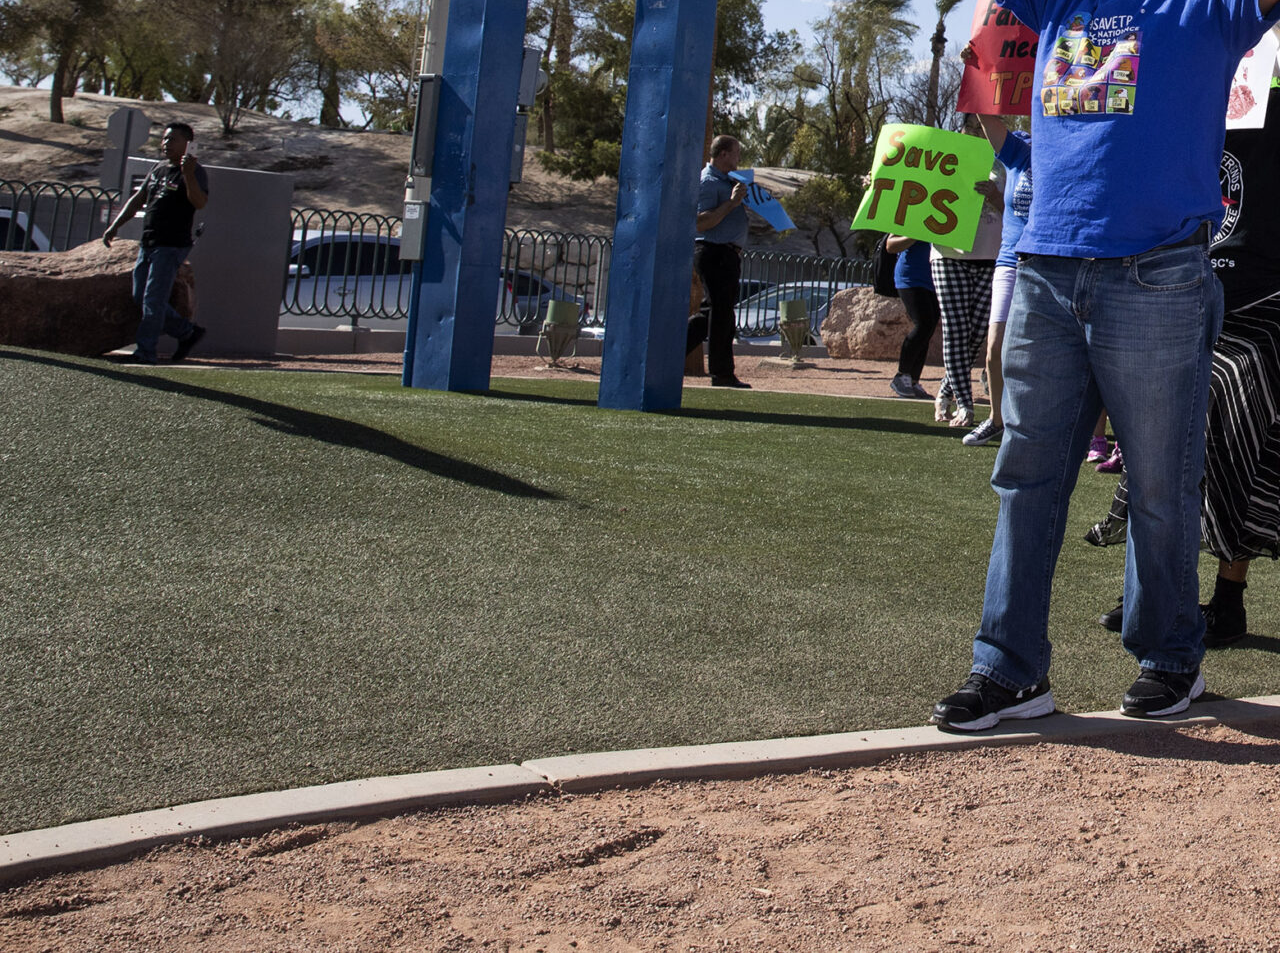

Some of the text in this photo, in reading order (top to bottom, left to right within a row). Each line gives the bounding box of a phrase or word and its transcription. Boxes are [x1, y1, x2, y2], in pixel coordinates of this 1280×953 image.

[881, 130, 959, 176] Save
[866, 177, 960, 236] TPS
[1212, 208, 1238, 243] MITTEE
